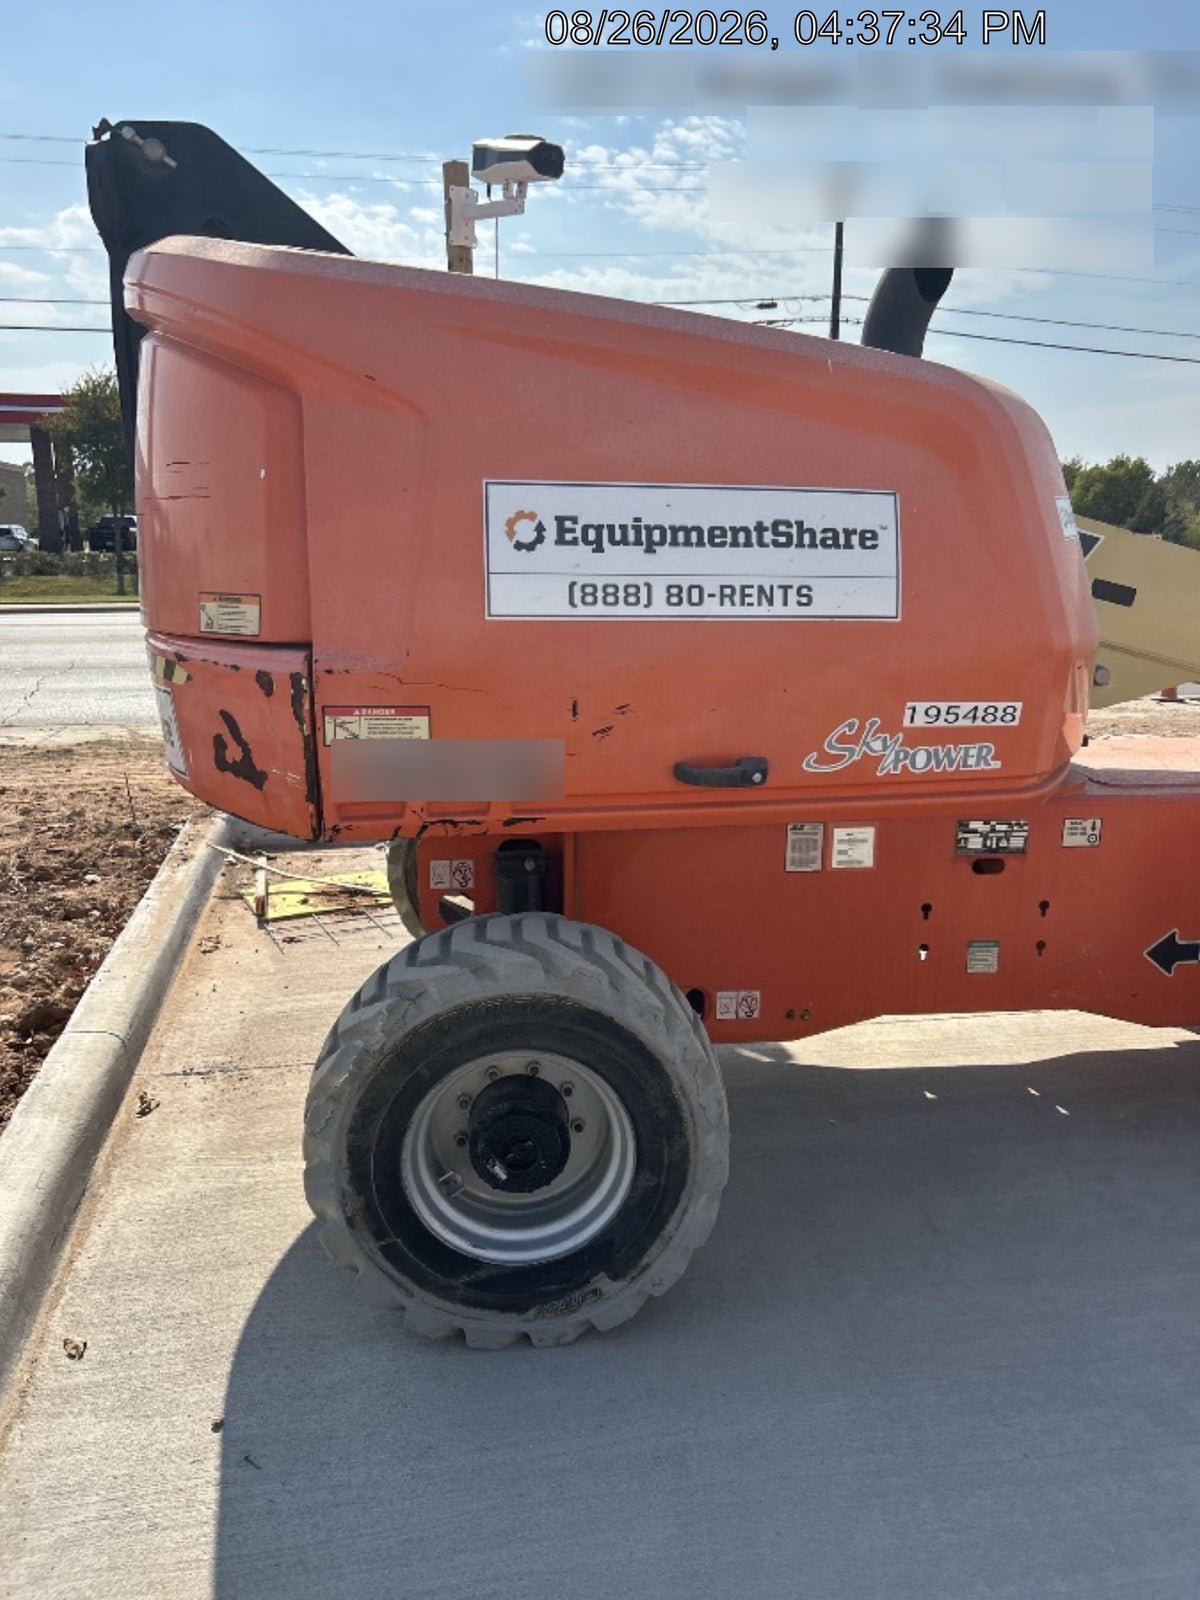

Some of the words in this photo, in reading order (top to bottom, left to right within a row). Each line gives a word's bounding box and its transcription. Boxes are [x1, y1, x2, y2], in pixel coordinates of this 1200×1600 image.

[553, 515, 880, 554] EquipmentShare
[568, 582, 653, 608] (888)
[666, 583, 814, 608] 80-RENTS
[906, 704, 1019, 726] 195488
